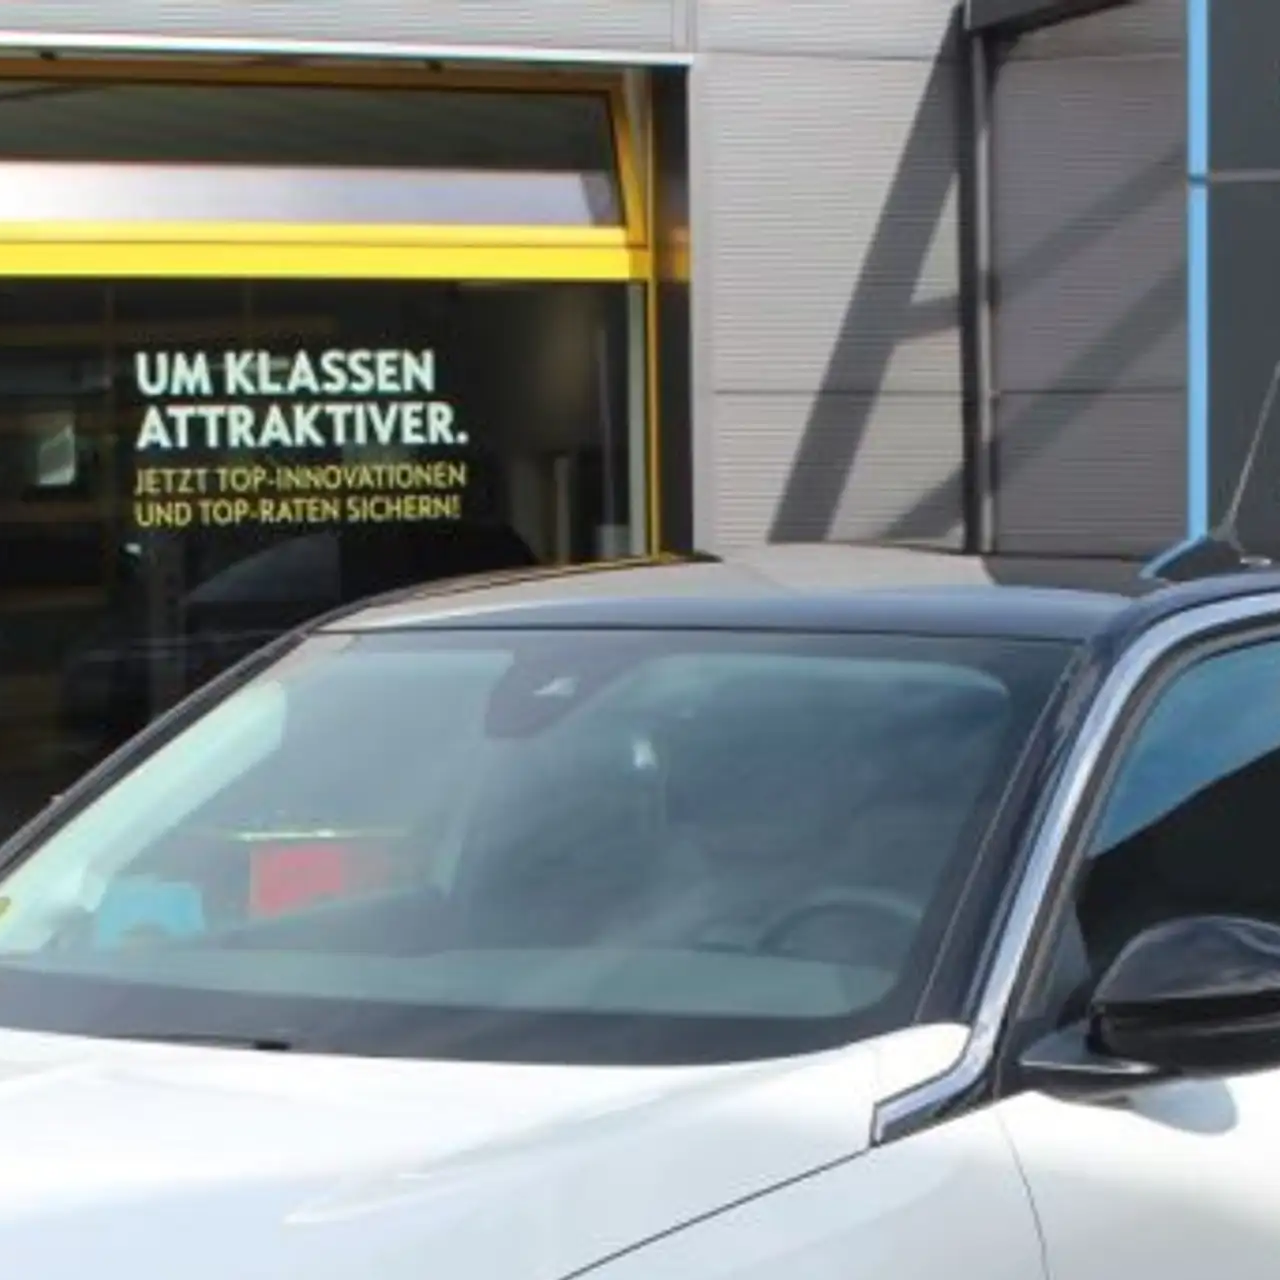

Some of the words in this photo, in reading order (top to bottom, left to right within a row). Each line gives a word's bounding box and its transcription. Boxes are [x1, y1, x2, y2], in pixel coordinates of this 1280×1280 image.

[135, 352, 213, 395] UM
[224, 350, 435, 394] KLASSEN
[136, 402, 469, 449] ATTRAKTIVER.
[135, 467, 209, 495] JETZT
[219, 463, 467, 492] TOP-INNOVATIONEN
[135, 501, 191, 527] UND
[200, 498, 339, 525] TOP-RATEN
[346, 495, 461, 522] SICHERN!
